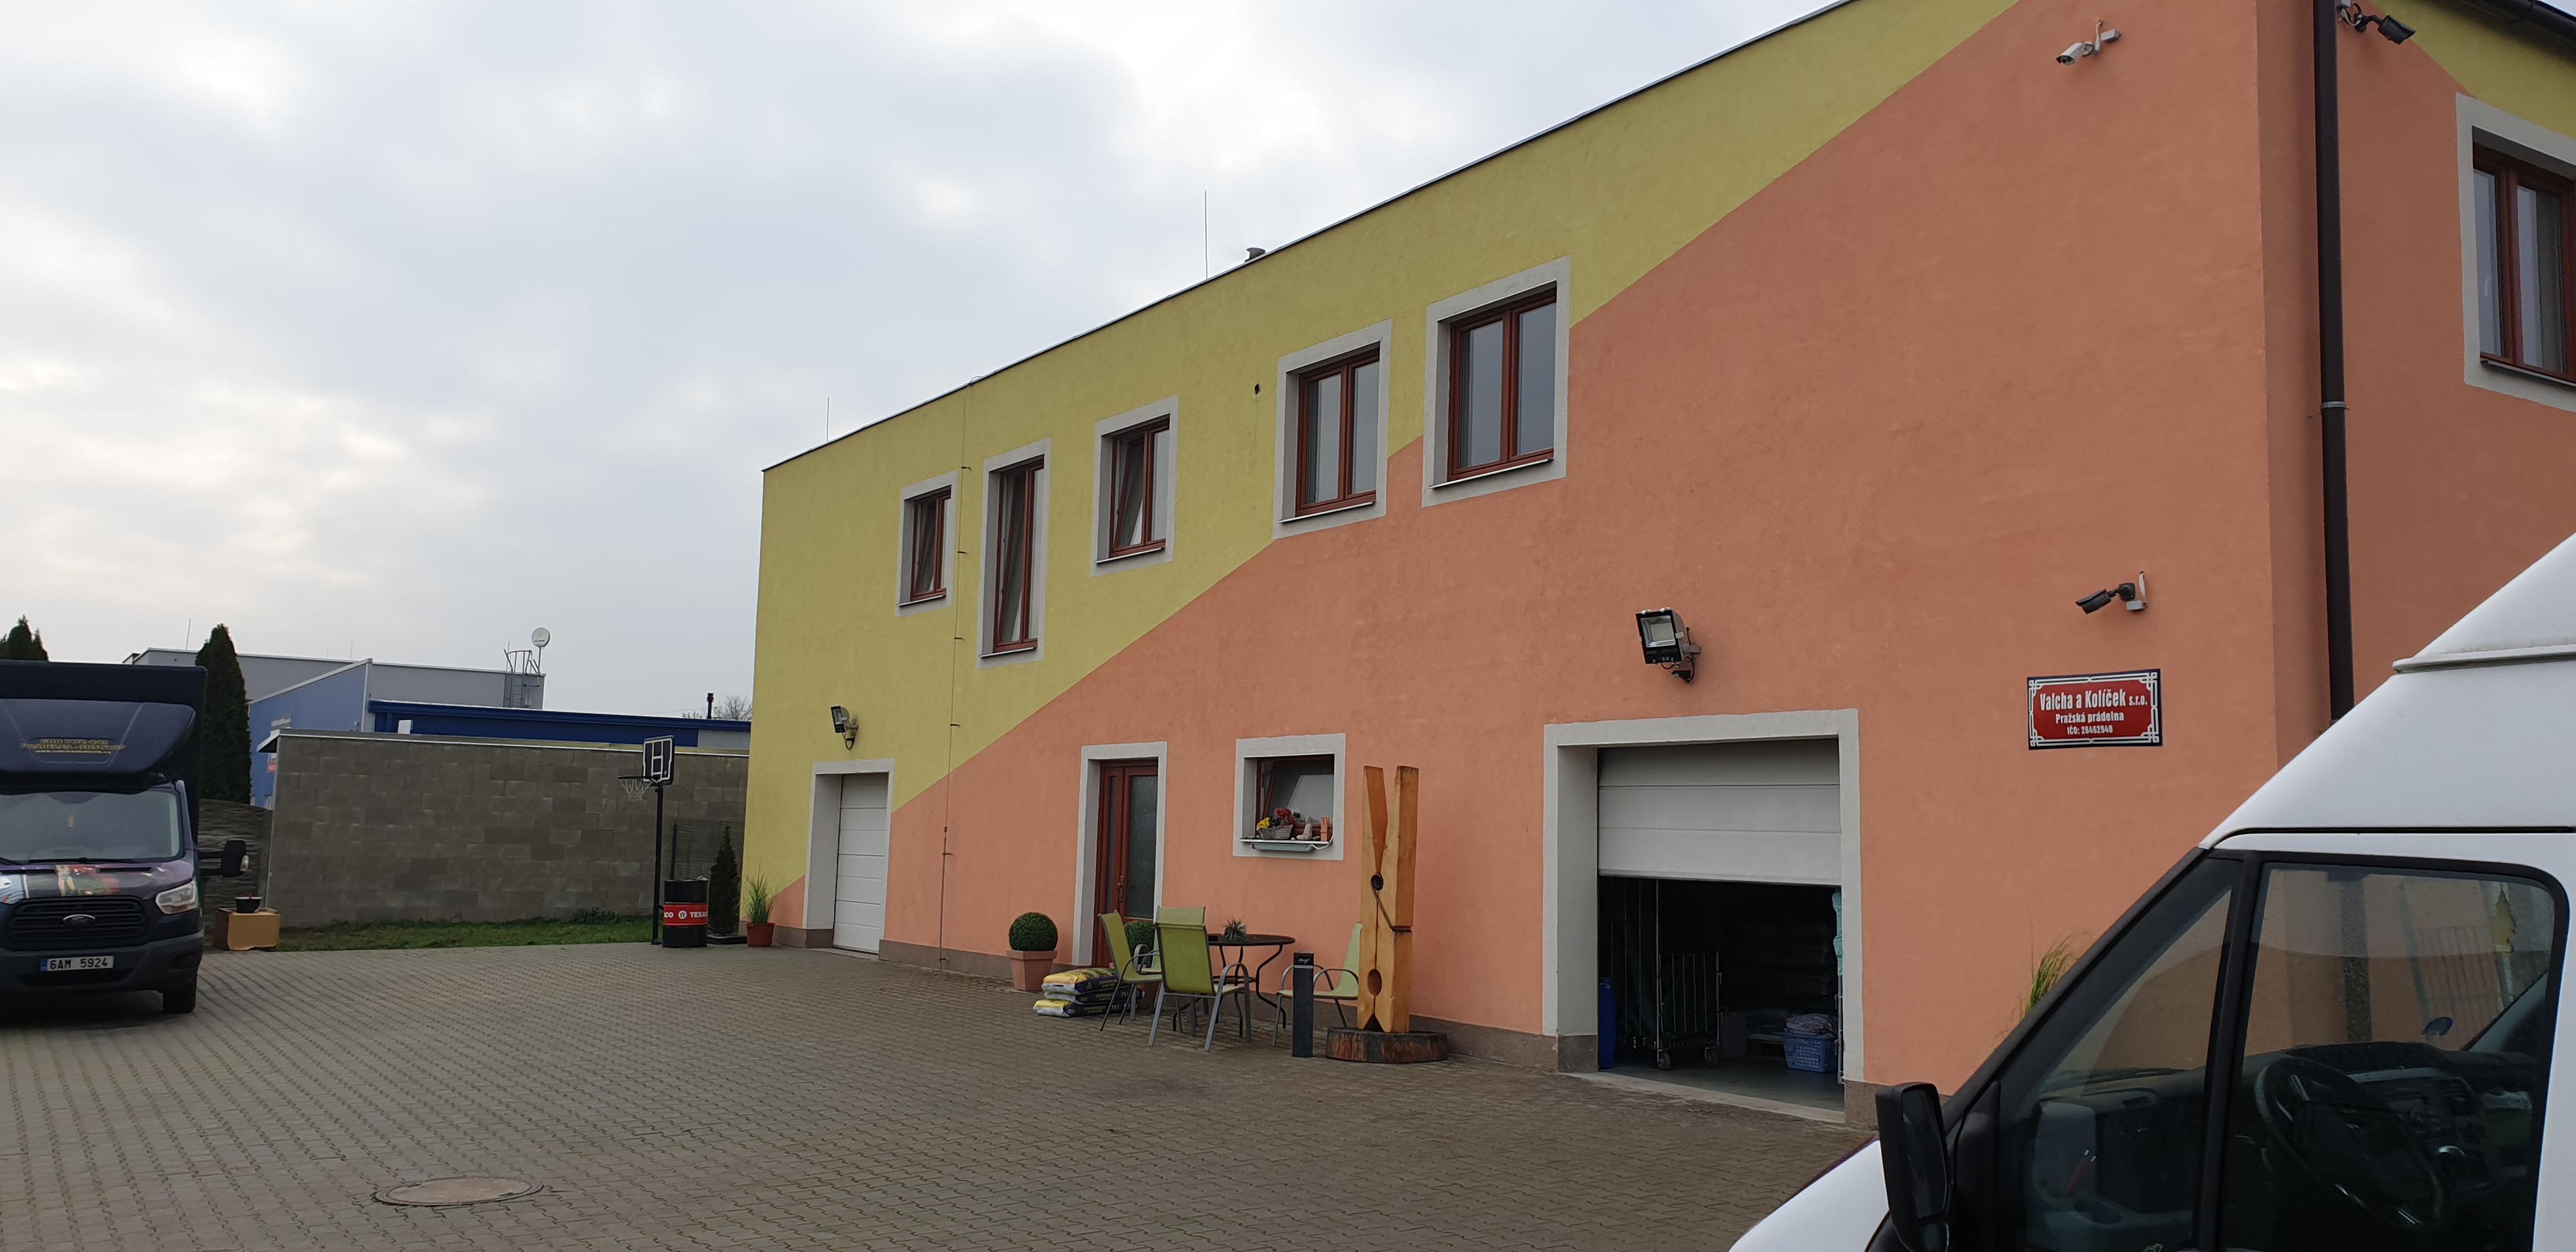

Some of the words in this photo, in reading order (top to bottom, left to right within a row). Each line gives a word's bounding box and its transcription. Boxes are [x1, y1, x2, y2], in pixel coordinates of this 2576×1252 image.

[2040, 692, 2073, 711] Valcha
[2076, 694, 2082, 708] a
[2085, 688, 2126, 708] Kolíček
[2128, 695, 2148, 706] s.r.o.
[2056, 712, 2085, 724] Pražská
[2088, 711, 2125, 723] prádelna
[2067, 725, 2080, 735] IČO:
[50, 960, 71, 970] 6AM
[80, 958, 108, 968] 5924
